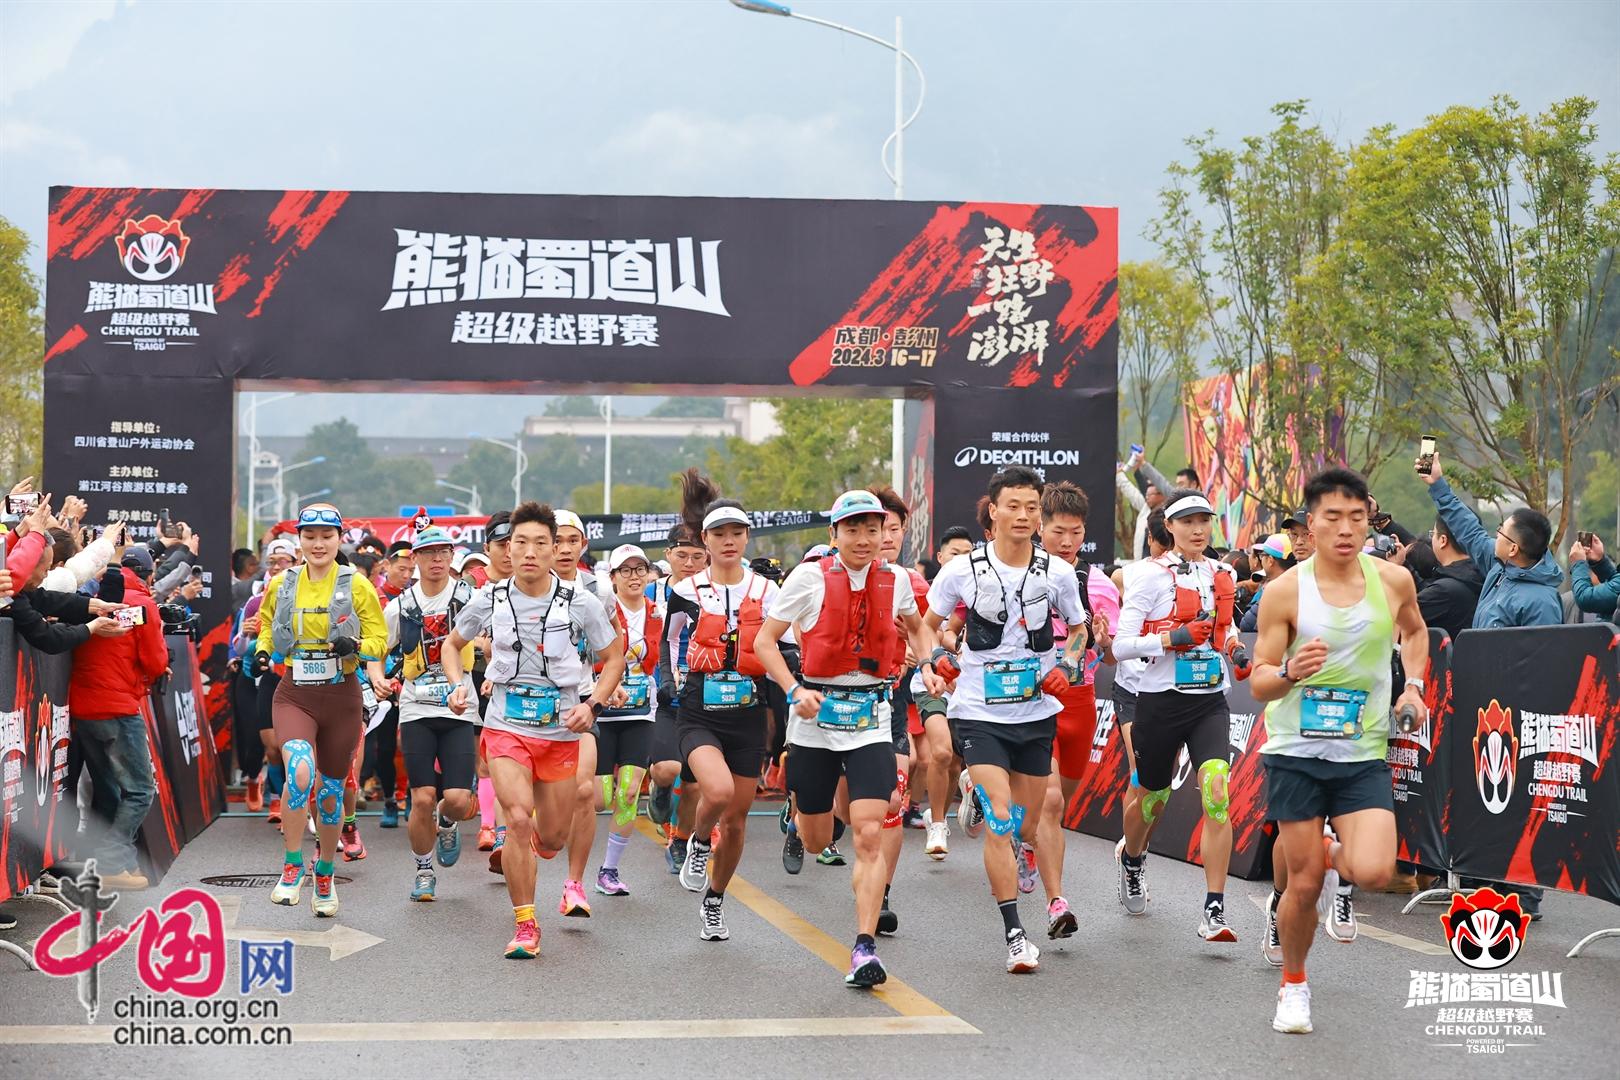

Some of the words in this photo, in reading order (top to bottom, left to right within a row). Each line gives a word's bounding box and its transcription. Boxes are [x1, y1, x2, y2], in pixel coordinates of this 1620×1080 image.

[976, 226, 1039, 264] 天生
[380, 228, 731, 317] 熊猫蜀道山
[985, 259, 1055, 298] 狂野
[84, 281, 217, 314] 熊猫蜀道山
[967, 293, 1033, 325] 一路
[110, 312, 190, 326] 超级越野赛
[101, 326, 162, 336] CHENGDU
[165, 327, 200, 336] TRAIL
[451, 311, 660, 347] 超级越野赛
[133, 343, 165, 351] TSAIGU
[967, 320, 1050, 367] 澎湃
[830, 347, 885, 367] 2024.3
[74, 436, 195, 450] 四川省登山户外运动协会
[991, 432, 1049, 443] 荣耀合作伙伴
[980, 450, 1079, 465] DECATHLON
[776, 515, 811, 526] TSAIGU
[303, 662, 325, 674] 5686
[428, 685, 448, 697] 5391
[1519, 709, 1599, 768] 熊猫蜀道山
[1386, 746, 1418, 768] 级越野赛
[1407, 769, 1423, 783] TRAIL
[1533, 760, 1581, 784] 超级越野赛
[1528, 783, 1564, 798] CHENGDU
[1566, 786, 1588, 802] TRAIL
[1547, 810, 1567, 823] TSAIGU
